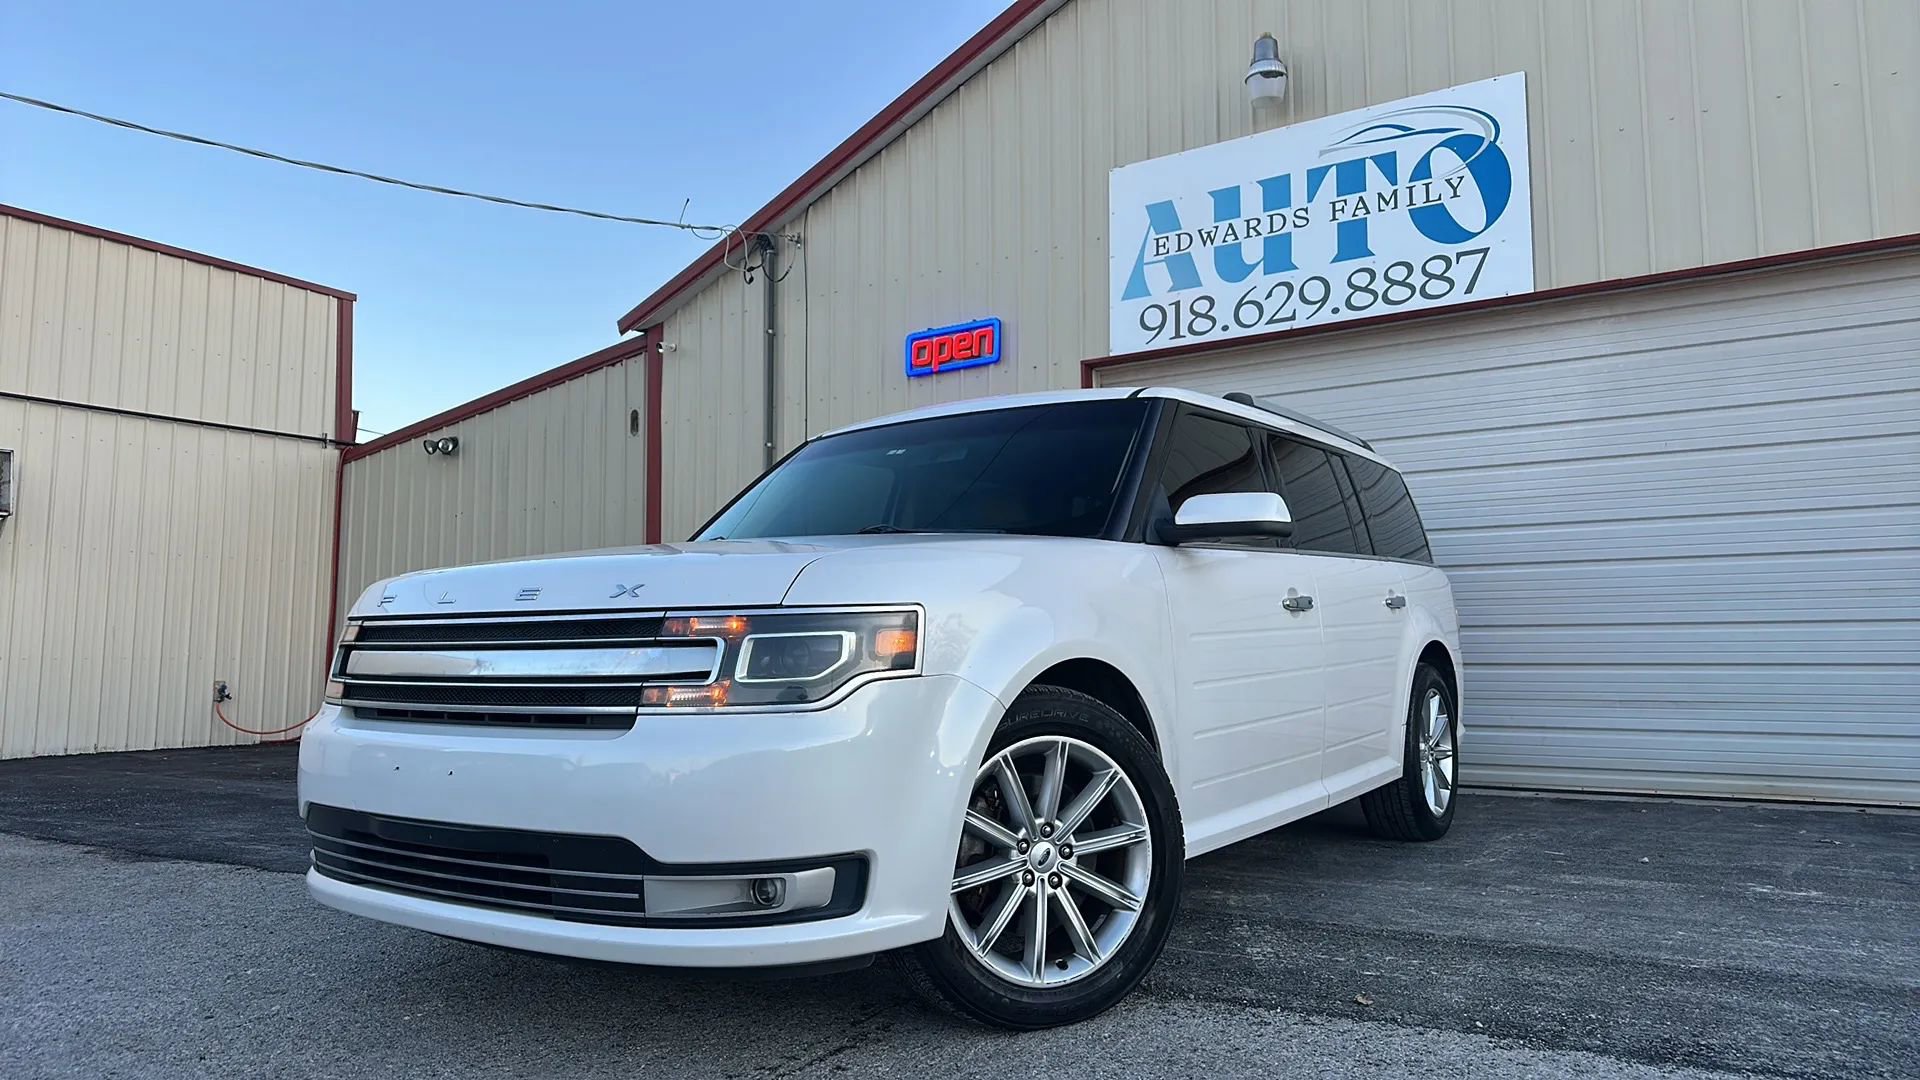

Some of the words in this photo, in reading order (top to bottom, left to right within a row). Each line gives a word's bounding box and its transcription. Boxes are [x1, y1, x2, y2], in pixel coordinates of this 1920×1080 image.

[1121, 134, 1512, 301] AUTO
[1153, 207, 1310, 257] EDWARDS
[1329, 175, 1464, 222] FAMILY
[1139, 247, 1490, 344] 918.629.8887
[912, 327, 993, 372] open
[377, 583, 645, 607] FLEX
